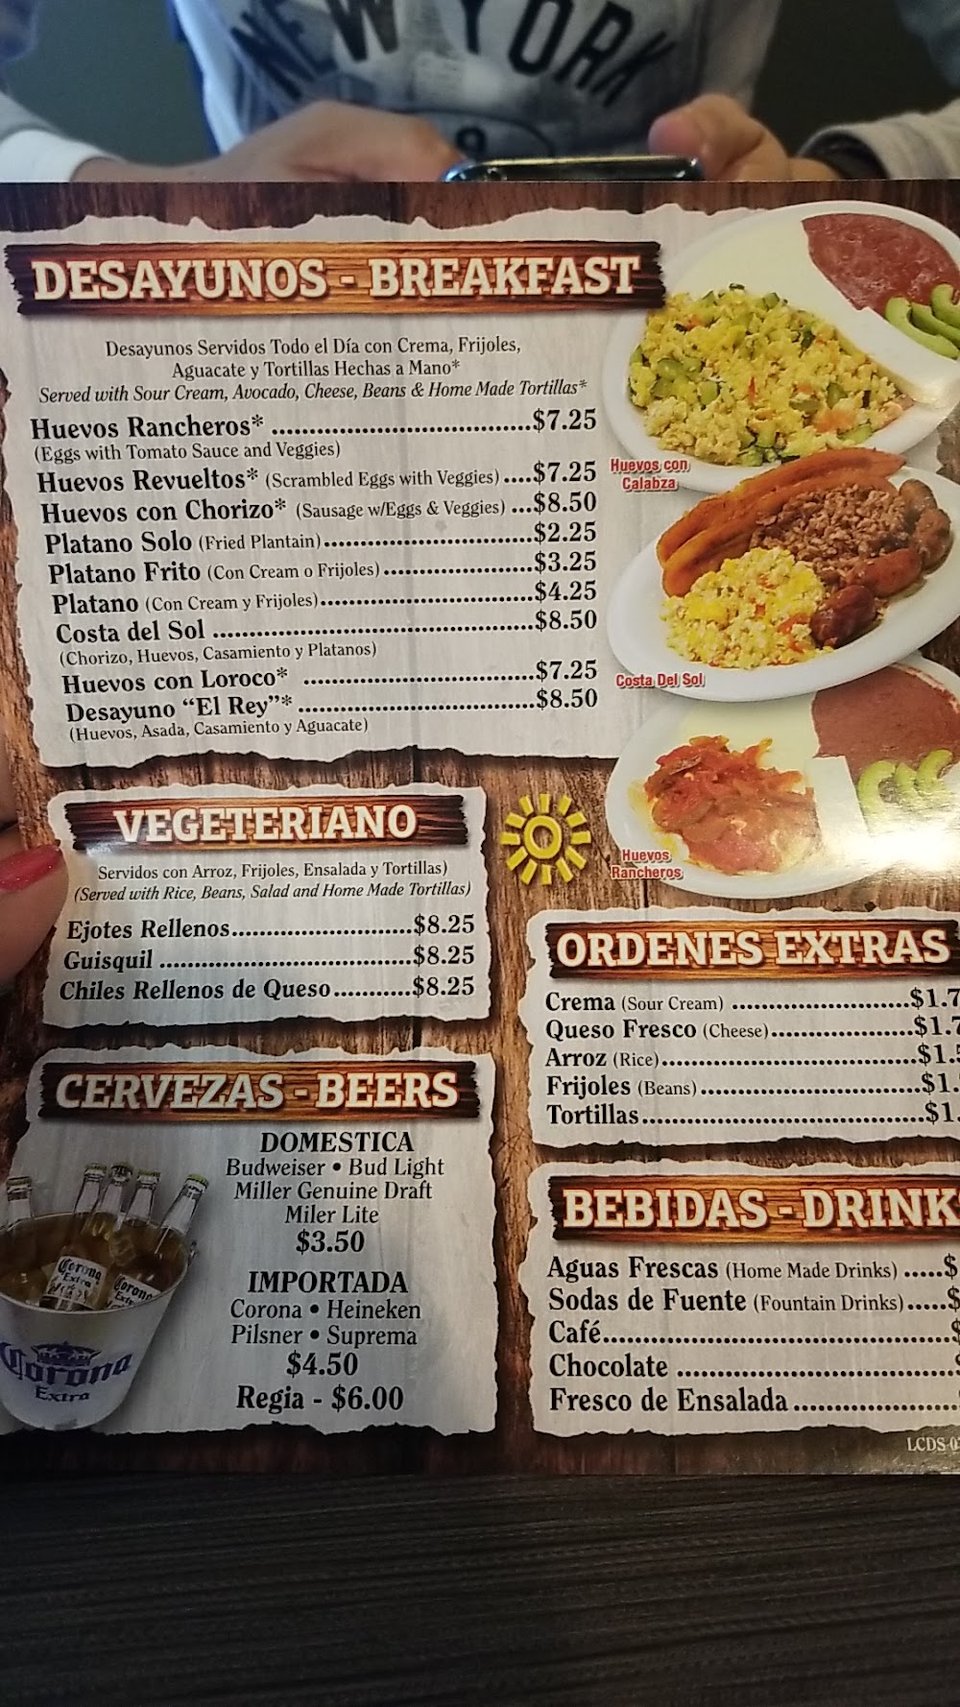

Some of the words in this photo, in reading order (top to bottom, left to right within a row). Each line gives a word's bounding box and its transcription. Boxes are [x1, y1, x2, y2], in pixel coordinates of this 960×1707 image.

[455, 0, 677, 106] YORK
[32, 260, 328, 300] DESAYUNOS
[369, 256, 640, 298] BREAKFAST
[106, 341, 192, 359] Desayunos
[198, 339, 265, 355] Servidos
[270, 338, 309, 354] Todo
[315, 338, 327, 353] el
[334, 338, 359, 353] Día
[365, 342, 391, 353] con
[398, 338, 452, 354] Crema,
[459, 336, 520, 355] Frijoles,
[173, 363, 245, 381] Aguacate
[264, 360, 329, 376] Tortillas
[335, 360, 390, 375] Hechas
[30, 419, 118, 439] Huevos
[533, 408, 596, 433] $7.25
[37, 472, 124, 492] Huevos
[266, 471, 352, 489] (Scrambled
[359, 472, 395, 489] Eggs
[399, 470, 432, 485] with
[437, 469, 499, 487] Veggies)
[534, 461, 596, 485] $7.25
[611, 458, 659, 473] Huevos
[663, 459, 688, 471] con
[622, 476, 677, 490] Calabza
[41, 503, 127, 523] Huevos
[137, 507, 177, 521] con
[297, 503, 363, 520] (Sausage
[368, 502, 421, 518] w/Eggs
[444, 500, 505, 517] Veggies)
[534, 491, 596, 515] $8.50
[45, 533, 132, 554] Platano
[142, 530, 192, 551] Solo
[199, 535, 245, 551] (Fried
[251, 534, 320, 548] Plantain)
[534, 521, 596, 545] $2.25
[48, 563, 135, 584] Platano
[144, 561, 200, 581] Frito
[208, 566, 244, 581] (Con
[250, 565, 299, 578] Cream
[318, 562, 379, 579] Frijoles)
[535, 551, 596, 574] $3.25
[57, 624, 120, 643] Costa
[128, 620, 160, 641] del
[169, 619, 205, 639] Sol
[535, 610, 596, 632] $8.50
[60, 651, 132, 667] (Chorizo,
[137, 649, 198, 662] Huevos,
[203, 645, 290, 660] Casamiento
[308, 642, 376, 657] Platanos)
[616, 673, 653, 687] Costa
[657, 673, 678, 686] Del
[682, 672, 703, 685] Sol
[66, 704, 175, 724] Desayuno
[537, 688, 597, 710] $8.50
[113, 804, 417, 844] VEGETERIANO
[622, 849, 670, 861] Huevos
[98, 865, 158, 879] Servidos
[163, 869, 187, 878] con
[192, 865, 236, 879] Arroz,
[242, 863, 298, 879] Frijoles,
[305, 862, 366, 876] Ensalada
[383, 861, 447, 876] Tortillas)
[611, 866, 683, 879] Rancheros
[75, 887, 126, 902] (Served
[129, 886, 159, 900] with
[163, 886, 196, 901] Rice,
[201, 886, 245, 900] Beans,
[251, 884, 290, 898] Salad
[293, 884, 319, 897] and
[322, 884, 363, 896] Home
[367, 882, 404, 896] Made
[410, 881, 470, 896] Tortillas)
[67, 921, 132, 943] Ejotes
[141, 918, 229, 938] Rellenos
[414, 913, 474, 936] $8.25
[64, 949, 152, 973] Guisquil
[413, 944, 474, 967] $8.25
[555, 930, 765, 968] ORDENES
[775, 929, 951, 966] EXTRAS
[60, 981, 124, 1000] Chiles
[133, 979, 223, 999] Rellenos
[233, 979, 255, 998] de
[264, 979, 330, 1000] Queso
[413, 975, 474, 998] $8.25
[546, 992, 615, 1011] Crema
[622, 996, 663, 1011] (Sour
[669, 996, 723, 1011] Cream)
[546, 1020, 614, 1041] Queso
[623, 1019, 696, 1038] Fresco
[703, 1023, 768, 1039] (Cheese)
[545, 1048, 606, 1066] Arroz
[614, 1053, 659, 1068] (Rice)
[54, 1072, 284, 1110] CERVEZAS
[315, 1071, 459, 1108] BEERS
[547, 1075, 630, 1100] Frijoles
[638, 1081, 696, 1096] (Beans)
[547, 1103, 638, 1124] Tortillas
[260, 1132, 414, 1152] DOMESTICA
[226, 1158, 325, 1175] Budweiser
[349, 1157, 387, 1175] Bud
[395, 1157, 444, 1179] Light
[234, 1181, 291, 1199] Miller
[298, 1181, 377, 1199] Genuine
[385, 1180, 432, 1199] Draft
[285, 1205, 336, 1223] Miler
[343, 1206, 378, 1223] Lite
[563, 1188, 769, 1228] BEBIDAS
[803, 1187, 960, 1228] DRINK
[296, 1229, 364, 1255] $3.50
[58, 1258, 102, 1280] Corona
[63, 1273, 91, 1288] Extra
[547, 1256, 619, 1283] Aguas
[629, 1256, 718, 1278] Frescas
[726, 1262, 781, 1280] (Home
[788, 1262, 830, 1278] Made
[835, 1261, 897, 1280] Drinks)
[248, 1271, 408, 1293] IMPORTADA
[231, 1299, 302, 1318] Corona
[327, 1299, 420, 1319] Heineken
[549, 1287, 618, 1310] Sodas
[628, 1287, 653, 1310] de
[663, 1288, 746, 1311] Fuente
[754, 1295, 835, 1312] (Fountain
[841, 1294, 903, 1312] Drinks)
[231, 1324, 303, 1344] Pilsner
[327, 1325, 417, 1349] Suprema
[549, 1319, 600, 1343] Café
[0, 1342, 133, 1387] Corona
[287, 1350, 357, 1378] $4.50
[550, 1353, 668, 1377] Chocolate
[35, 1386, 90, 1402] Extra
[236, 1385, 304, 1414] Regia
[332, 1384, 403, 1412] $6.00
[550, 1388, 631, 1411] Fresco
[642, 1387, 668, 1411] de
[677, 1387, 788, 1411] Ensalada
